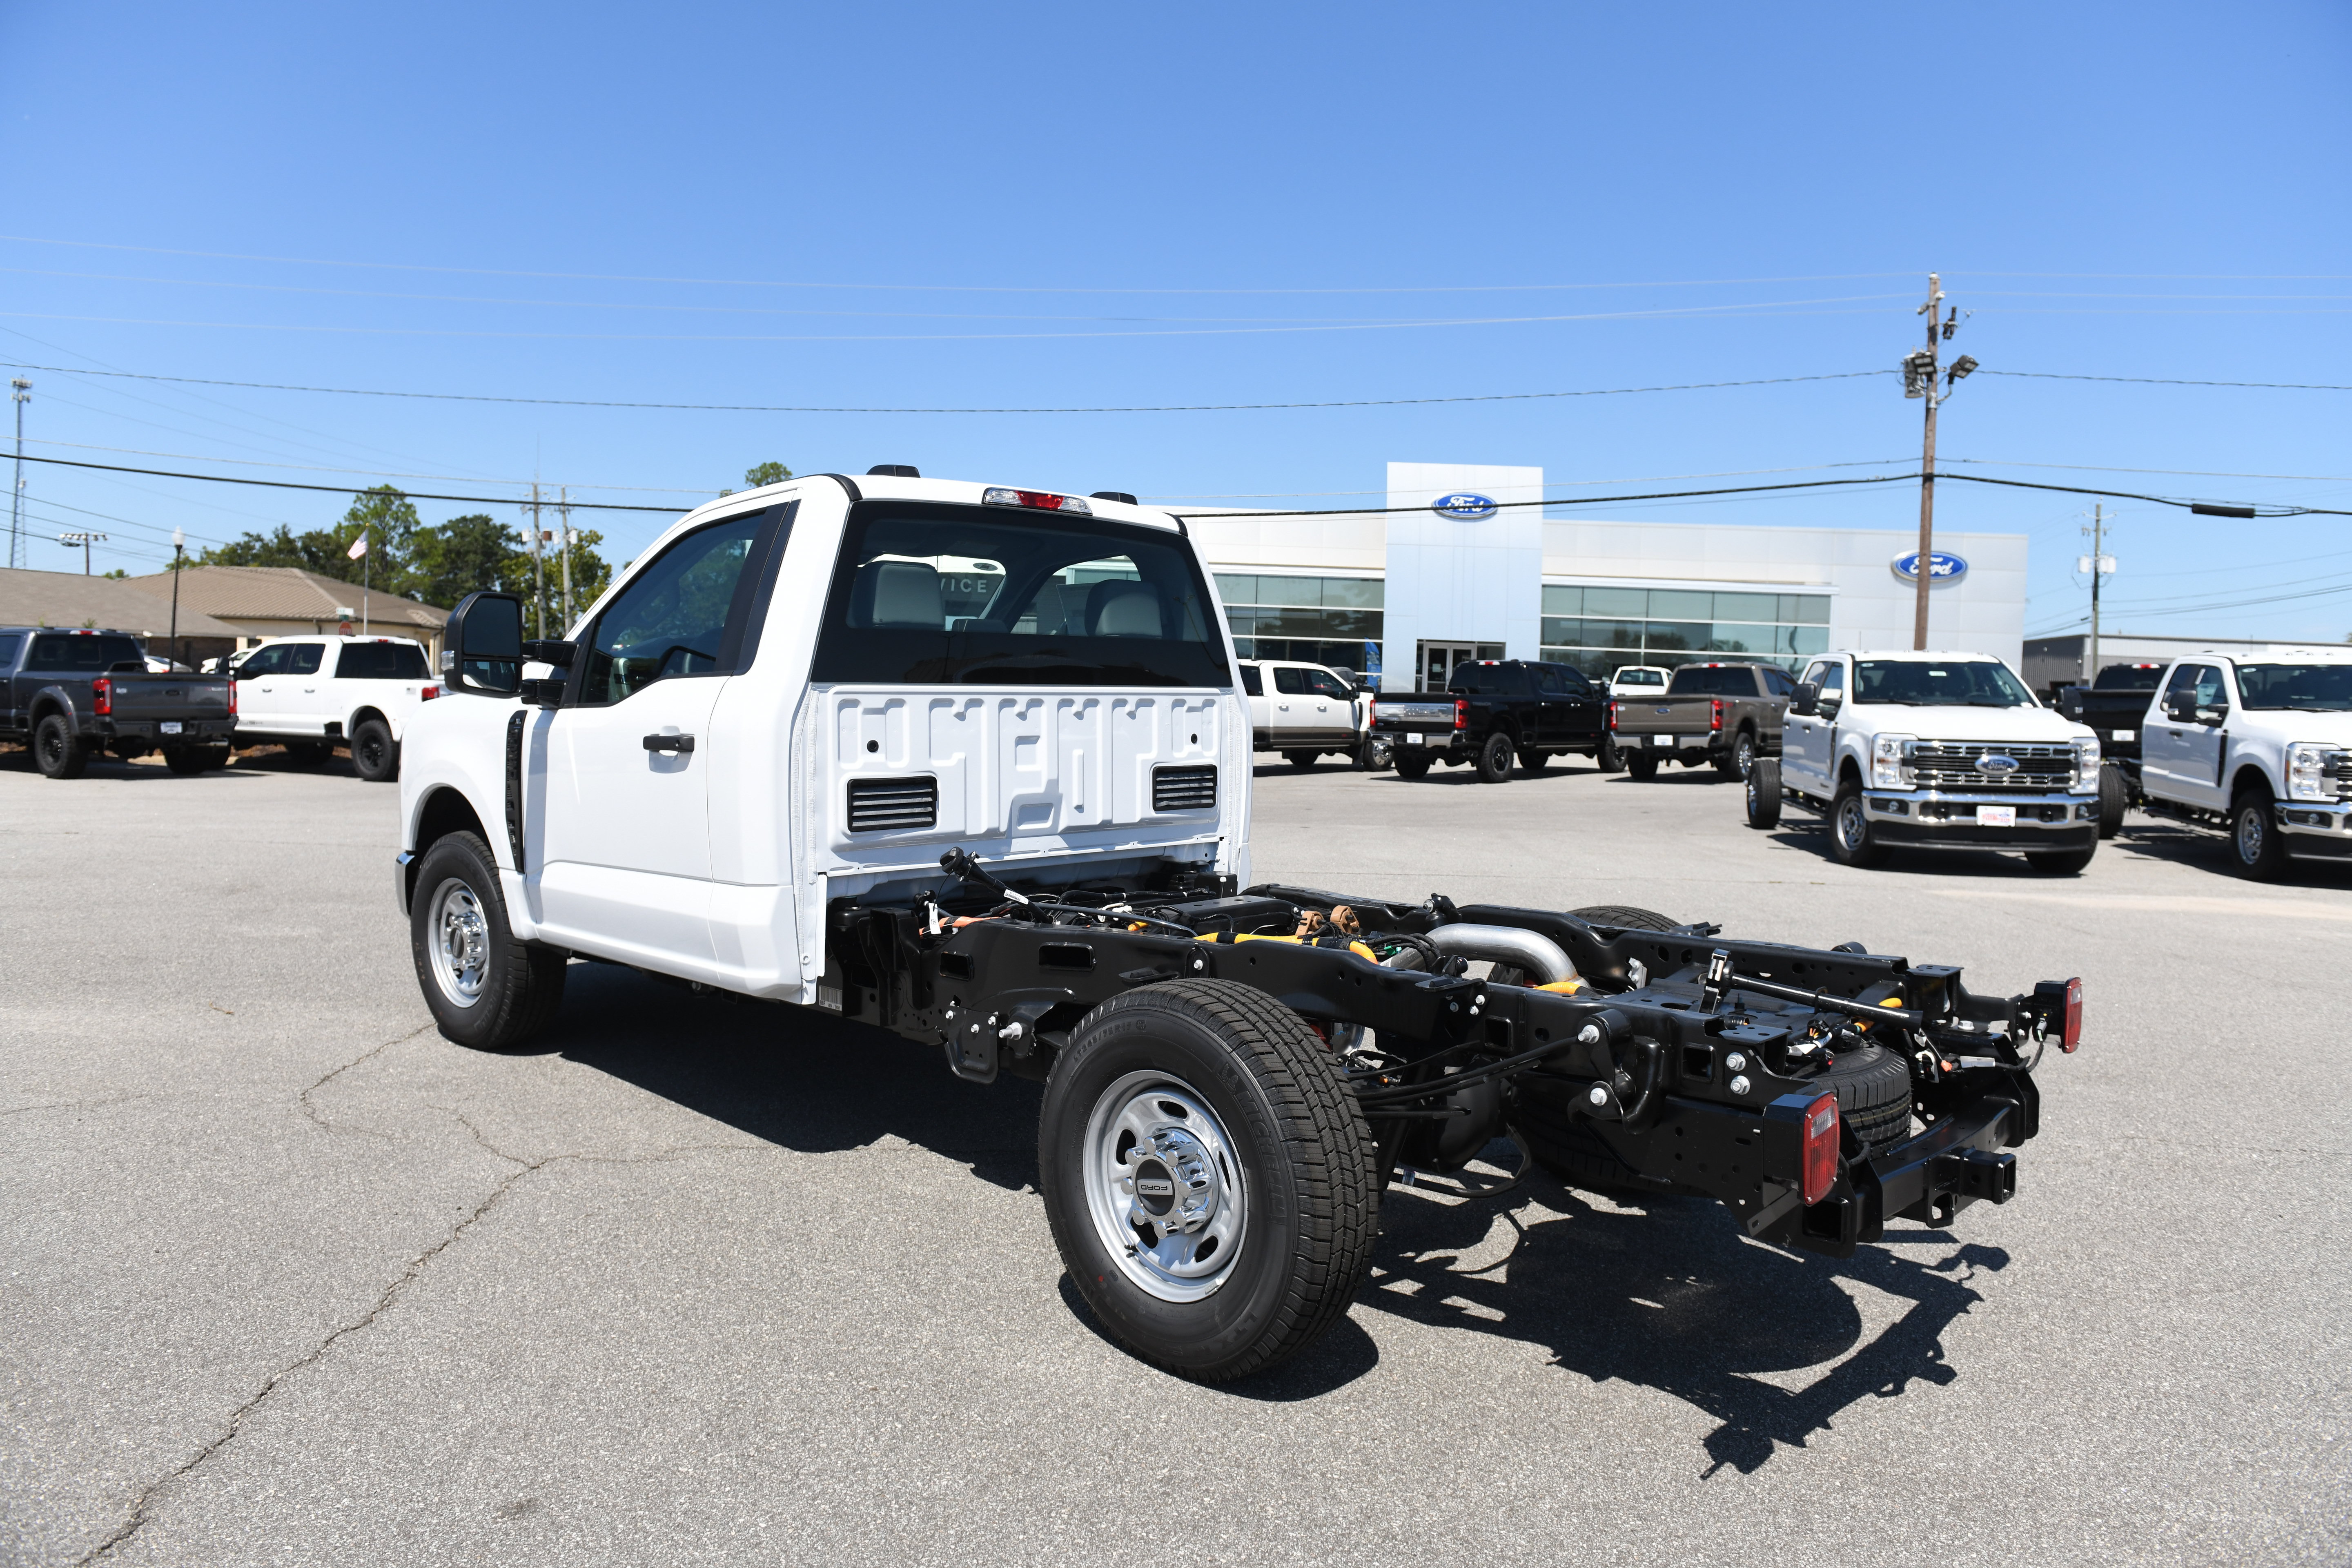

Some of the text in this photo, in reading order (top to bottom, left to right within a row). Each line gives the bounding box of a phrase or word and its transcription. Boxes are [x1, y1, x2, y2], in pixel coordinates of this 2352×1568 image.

[1446, 496, 1484, 512] Ford
[1909, 556, 1954, 575] Frd
[1236, 1090, 1287, 1213] MICHELIN
